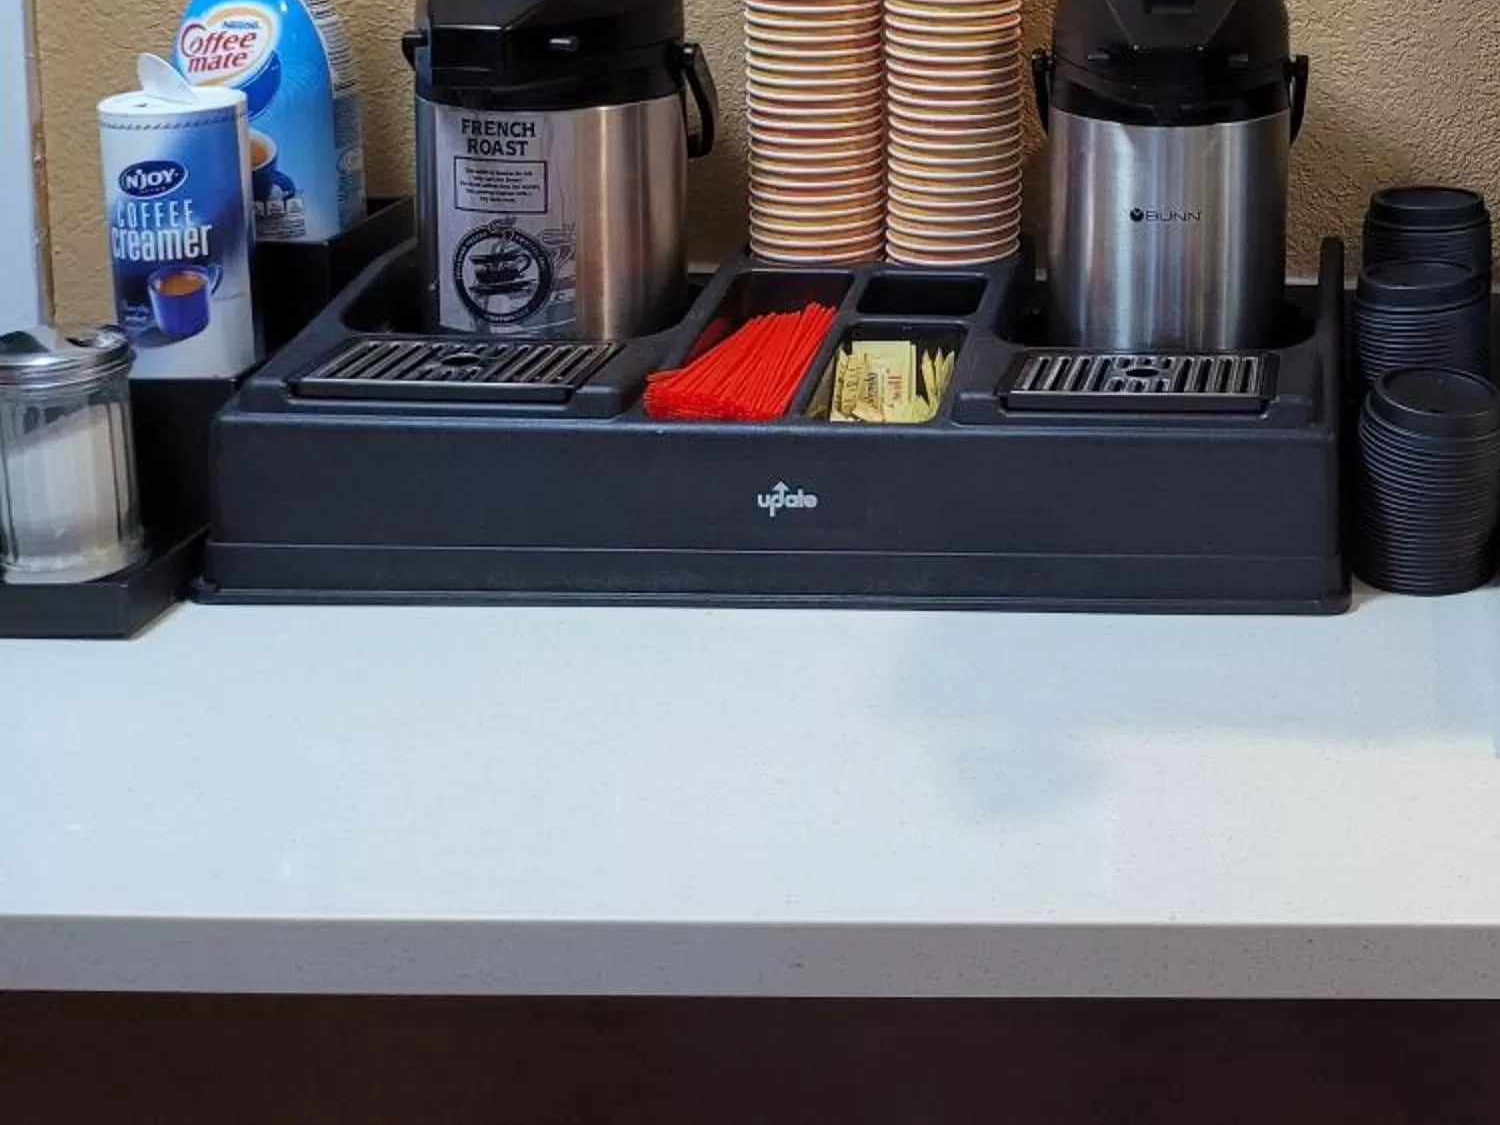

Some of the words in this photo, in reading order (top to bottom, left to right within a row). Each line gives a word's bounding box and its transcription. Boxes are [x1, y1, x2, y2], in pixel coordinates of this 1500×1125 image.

[181, 22, 258, 58] Coffee
[188, 52, 249, 74] mate
[460, 117, 537, 139] FRENCH
[466, 138, 529, 156] ROAST
[116, 198, 195, 229] COFFEE
[1145, 210, 1203, 222] BUNN
[111, 222, 213, 262] creamer
[757, 480, 819, 518] update
